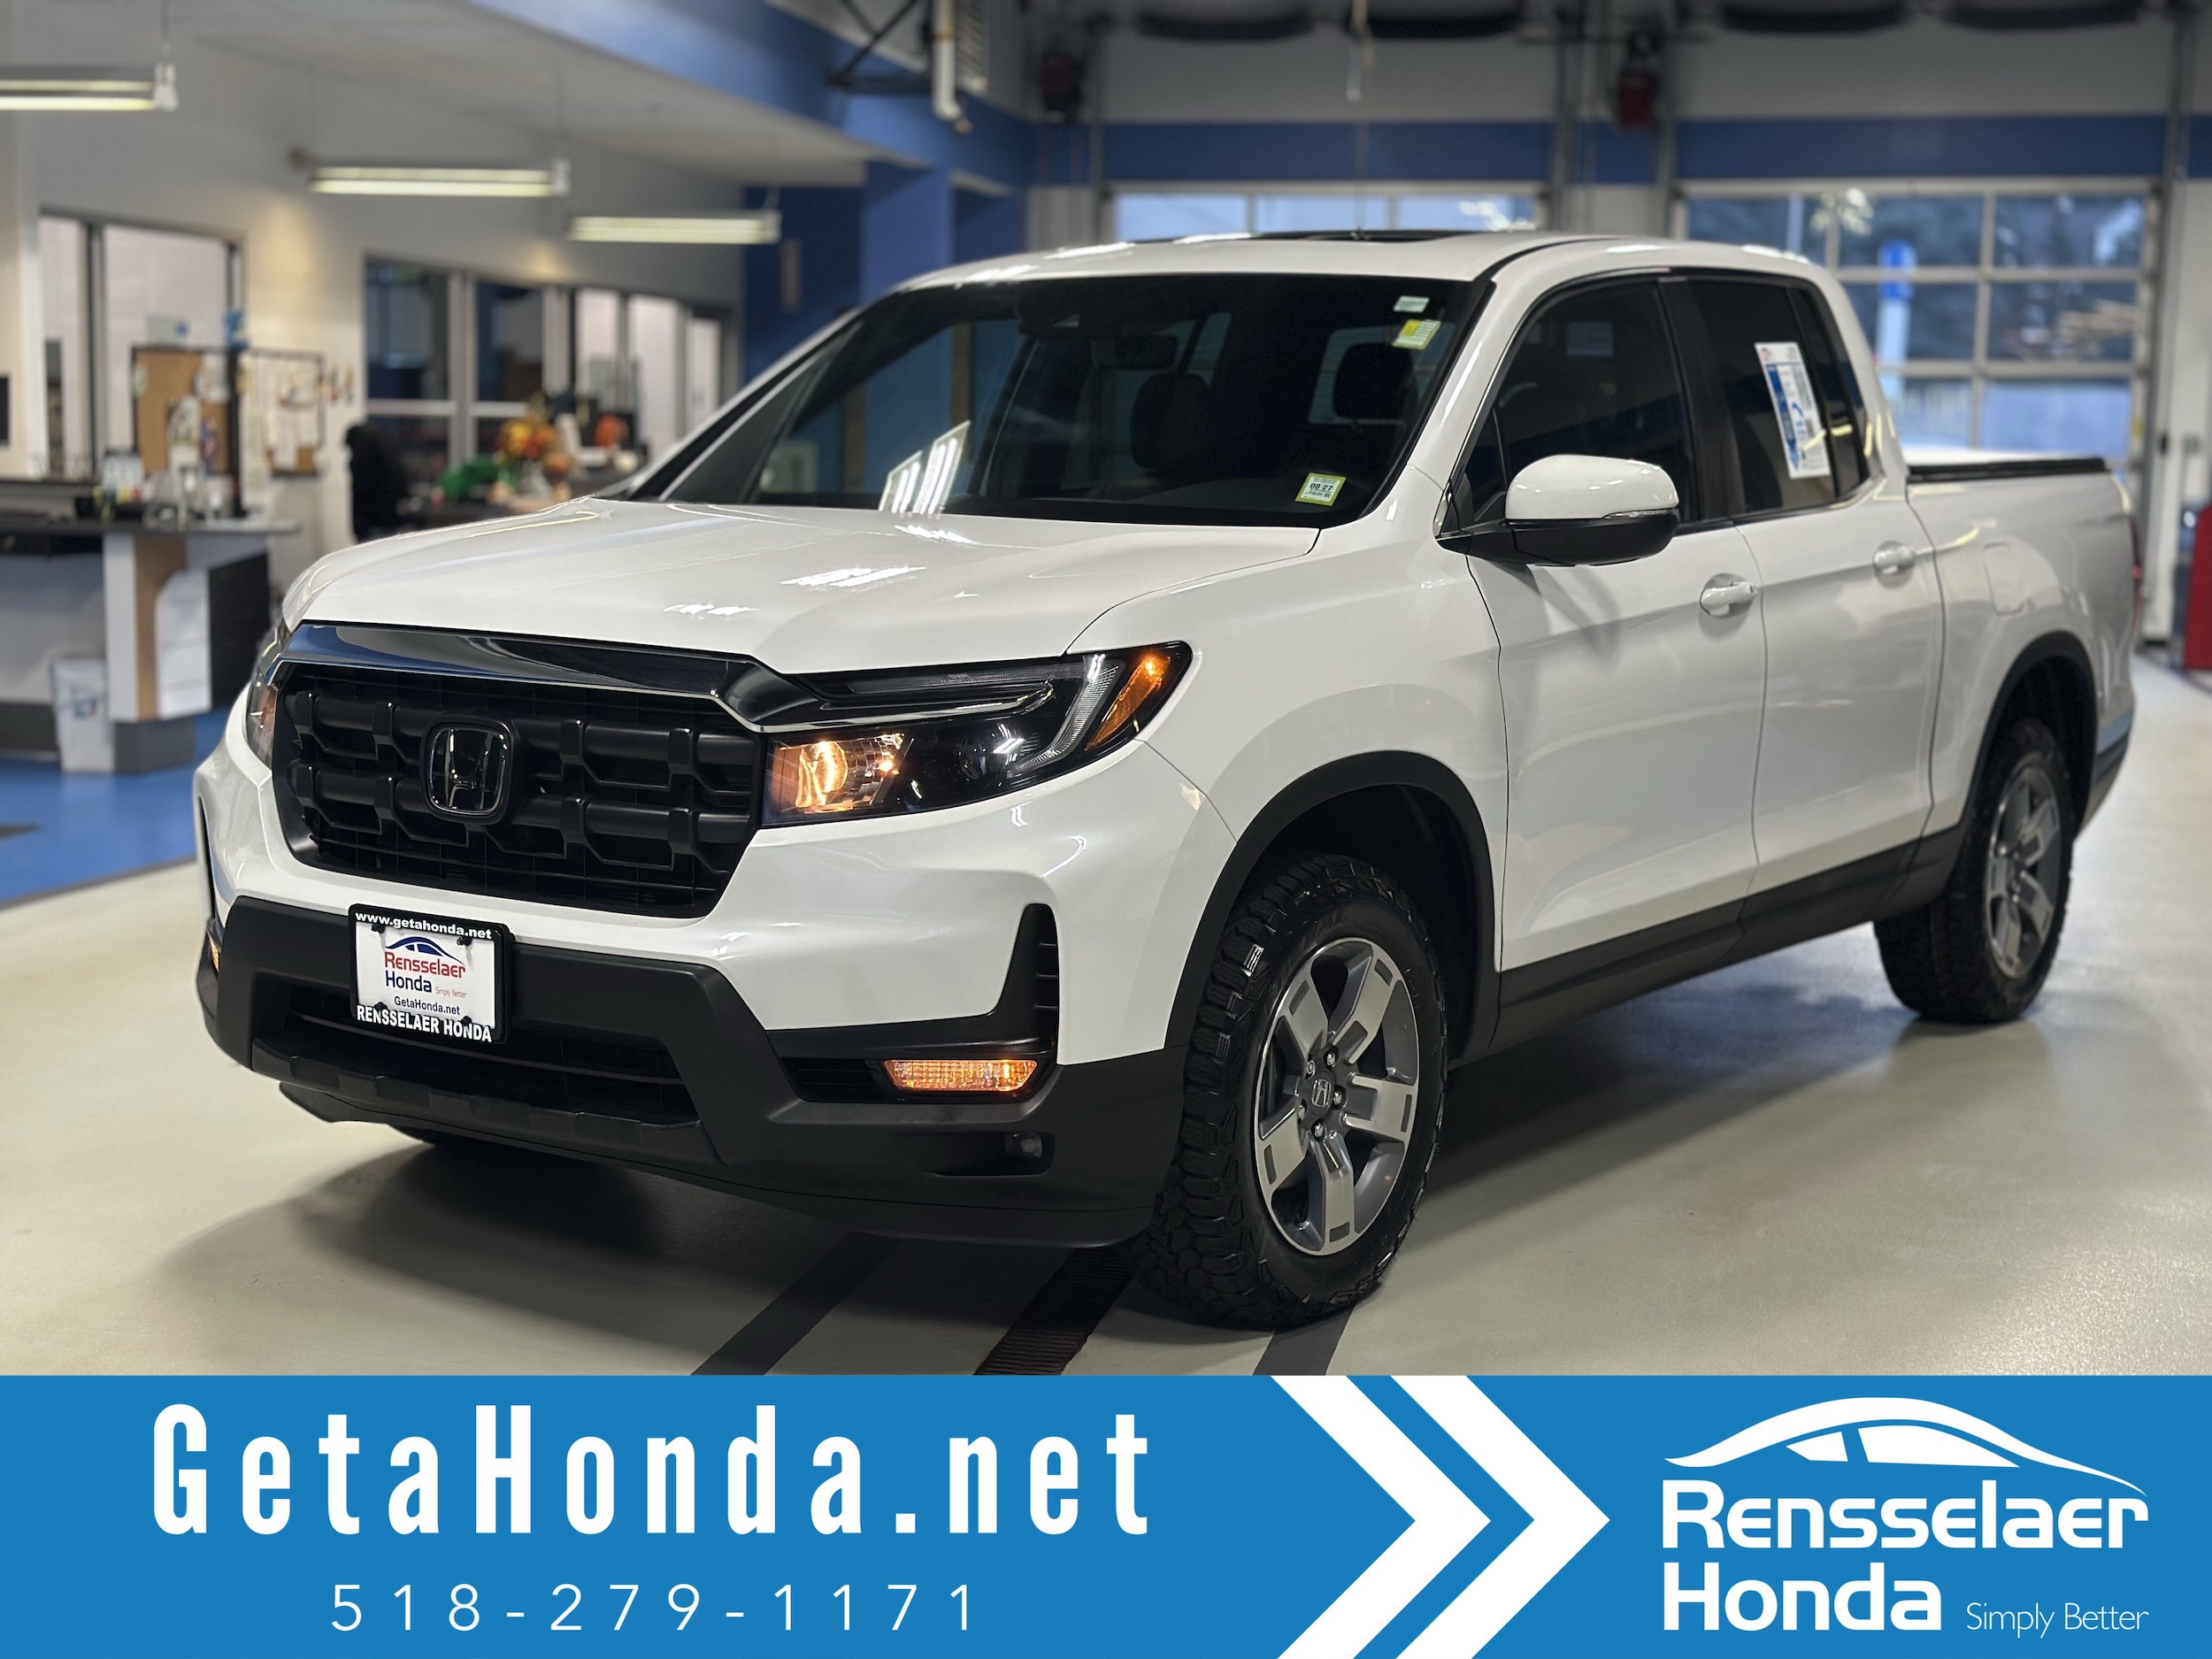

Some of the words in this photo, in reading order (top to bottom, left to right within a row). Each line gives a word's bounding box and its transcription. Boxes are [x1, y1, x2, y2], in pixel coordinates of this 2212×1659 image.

[355, 912, 492, 940] www.getahonda.net
[384, 951, 466, 979] Rensselaer
[385, 970, 433, 993] Honda
[394, 995, 460, 1015] GetaHonda.net
[357, 1004, 440, 1034] RENSSELAER
[443, 1018, 492, 1042] HONDA
